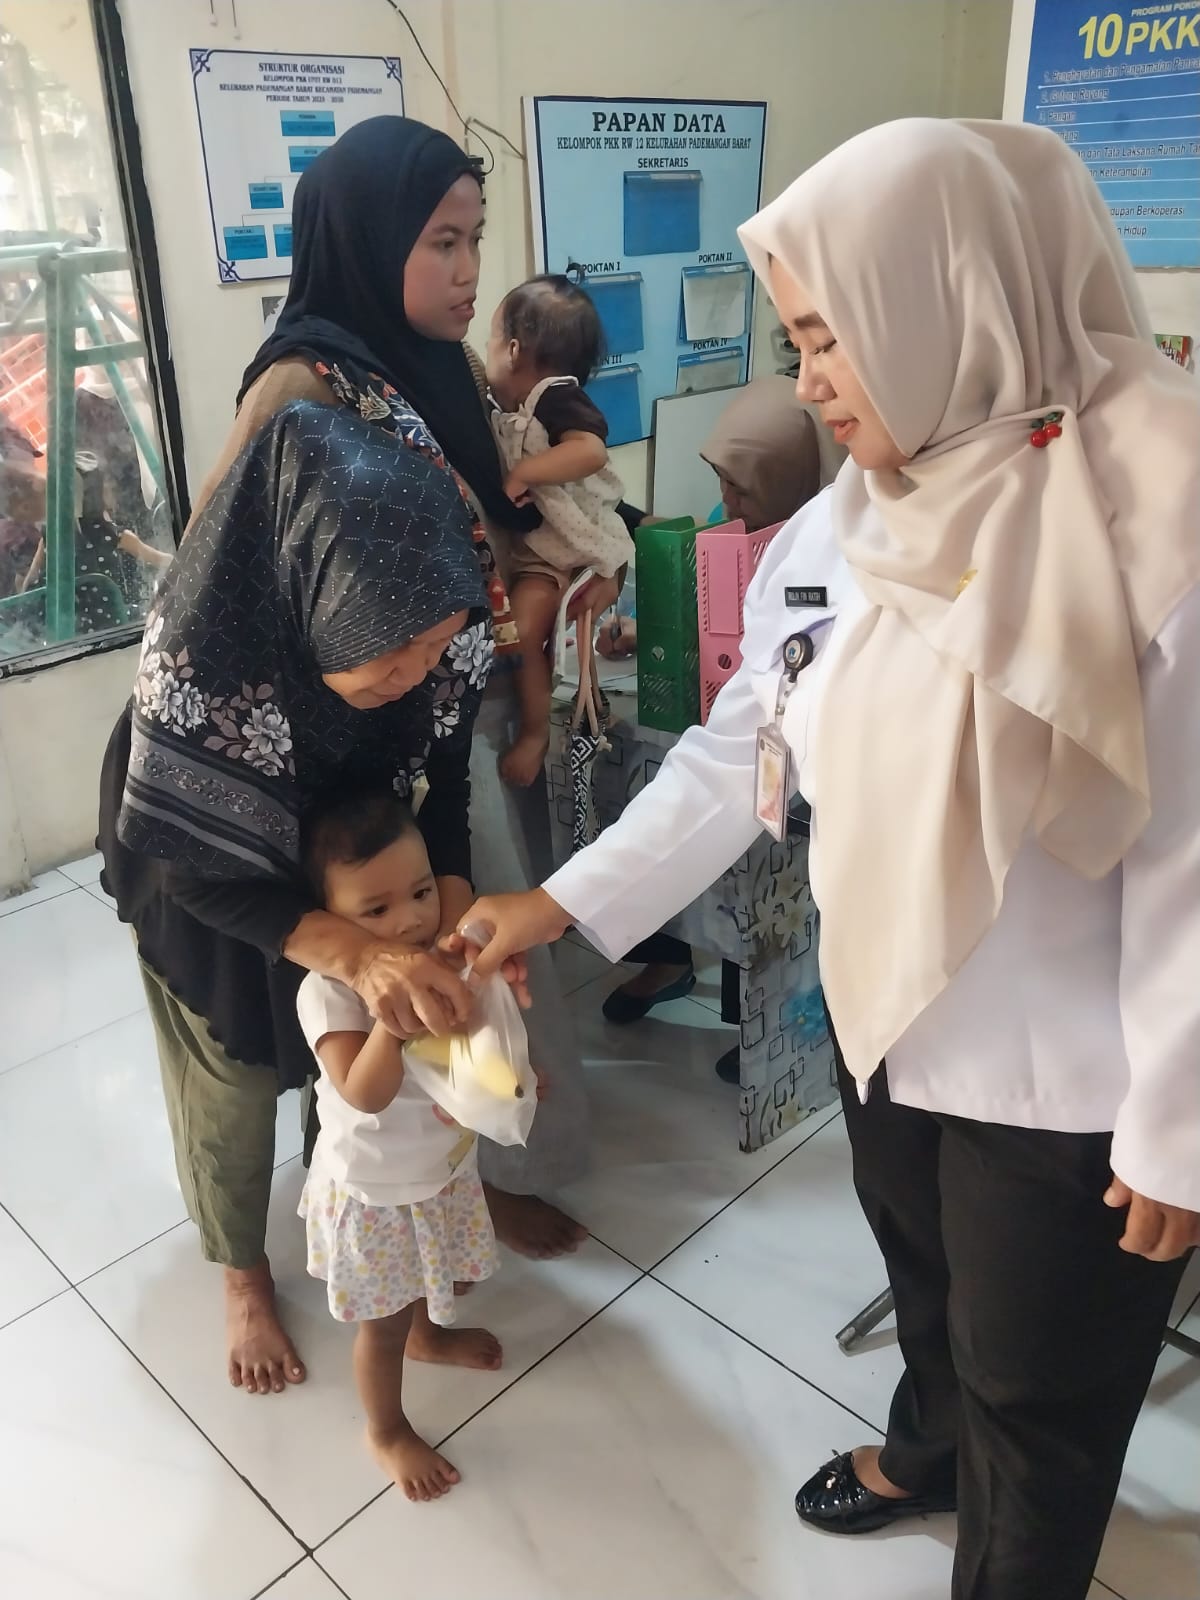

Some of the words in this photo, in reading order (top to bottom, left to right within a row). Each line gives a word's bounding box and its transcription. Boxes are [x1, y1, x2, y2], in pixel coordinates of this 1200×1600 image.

[1131, 4, 1172, 17] PROGRAM
[1079, 13, 1123, 59] 10
[1125, 13, 1200, 56] PKK
[258, 62, 299, 73] STRUKTUR
[300, 64, 345, 75] ORGANISASI
[219, 83, 254, 91] KELURAHAN
[256, 84, 294, 93] PADEMANGAN
[315, 86, 346, 94] KECAMATAN
[347, 87, 382, 95] PADEMANGAN
[592, 111, 666, 132] PAPAN
[673, 113, 726, 133] DATA
[557, 137, 602, 150] KELOMPOK
[603, 137, 619, 150] PKK
[621, 137, 633, 150] RW
[636, 137, 644, 150] 12
[645, 137, 687, 150] KELURAHAN
[688, 137, 731, 150] PADEMANGAN
[732, 137, 751, 150] BARAT
[1104, 146, 1121, 158] Tata
[1121, 145, 1155, 157] Laksana
[1157, 143, 1186, 155] Rumah
[638, 157, 689, 169] SEKRETARIS
[1100, 166, 1152, 178] Keterampilan
[1136, 205, 1184, 218] Berkoperasi
[1123, 225, 1147, 237] Hidup
[698, 253, 726, 263] POKTAN
[726, 252, 732, 261] II
[582, 262, 615, 273] POKTAN
[616, 261, 621, 271] I
[693, 339, 719, 351] POKTAN
[720, 338, 728, 347] IV
